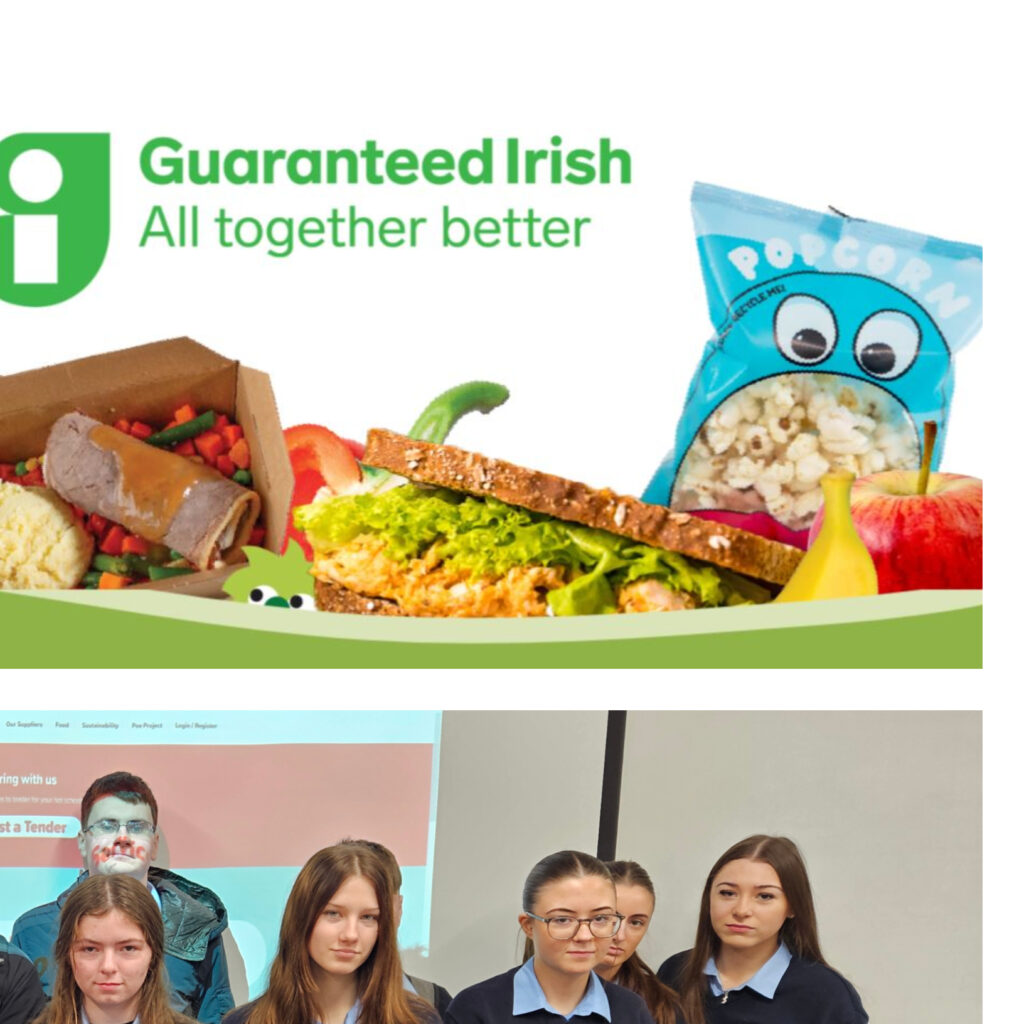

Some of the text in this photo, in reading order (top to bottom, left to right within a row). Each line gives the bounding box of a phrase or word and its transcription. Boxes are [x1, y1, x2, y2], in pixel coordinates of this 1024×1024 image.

[139, 135, 632, 186] Guaranteed Irish
[139, 205, 592, 257] All together better
[728, 233, 972, 318] POPCORN
[21, 774, 43, 785] with
[45, 776, 57, 785] us
[13, 824, 21, 833] a
[24, 820, 67, 833] Tender
